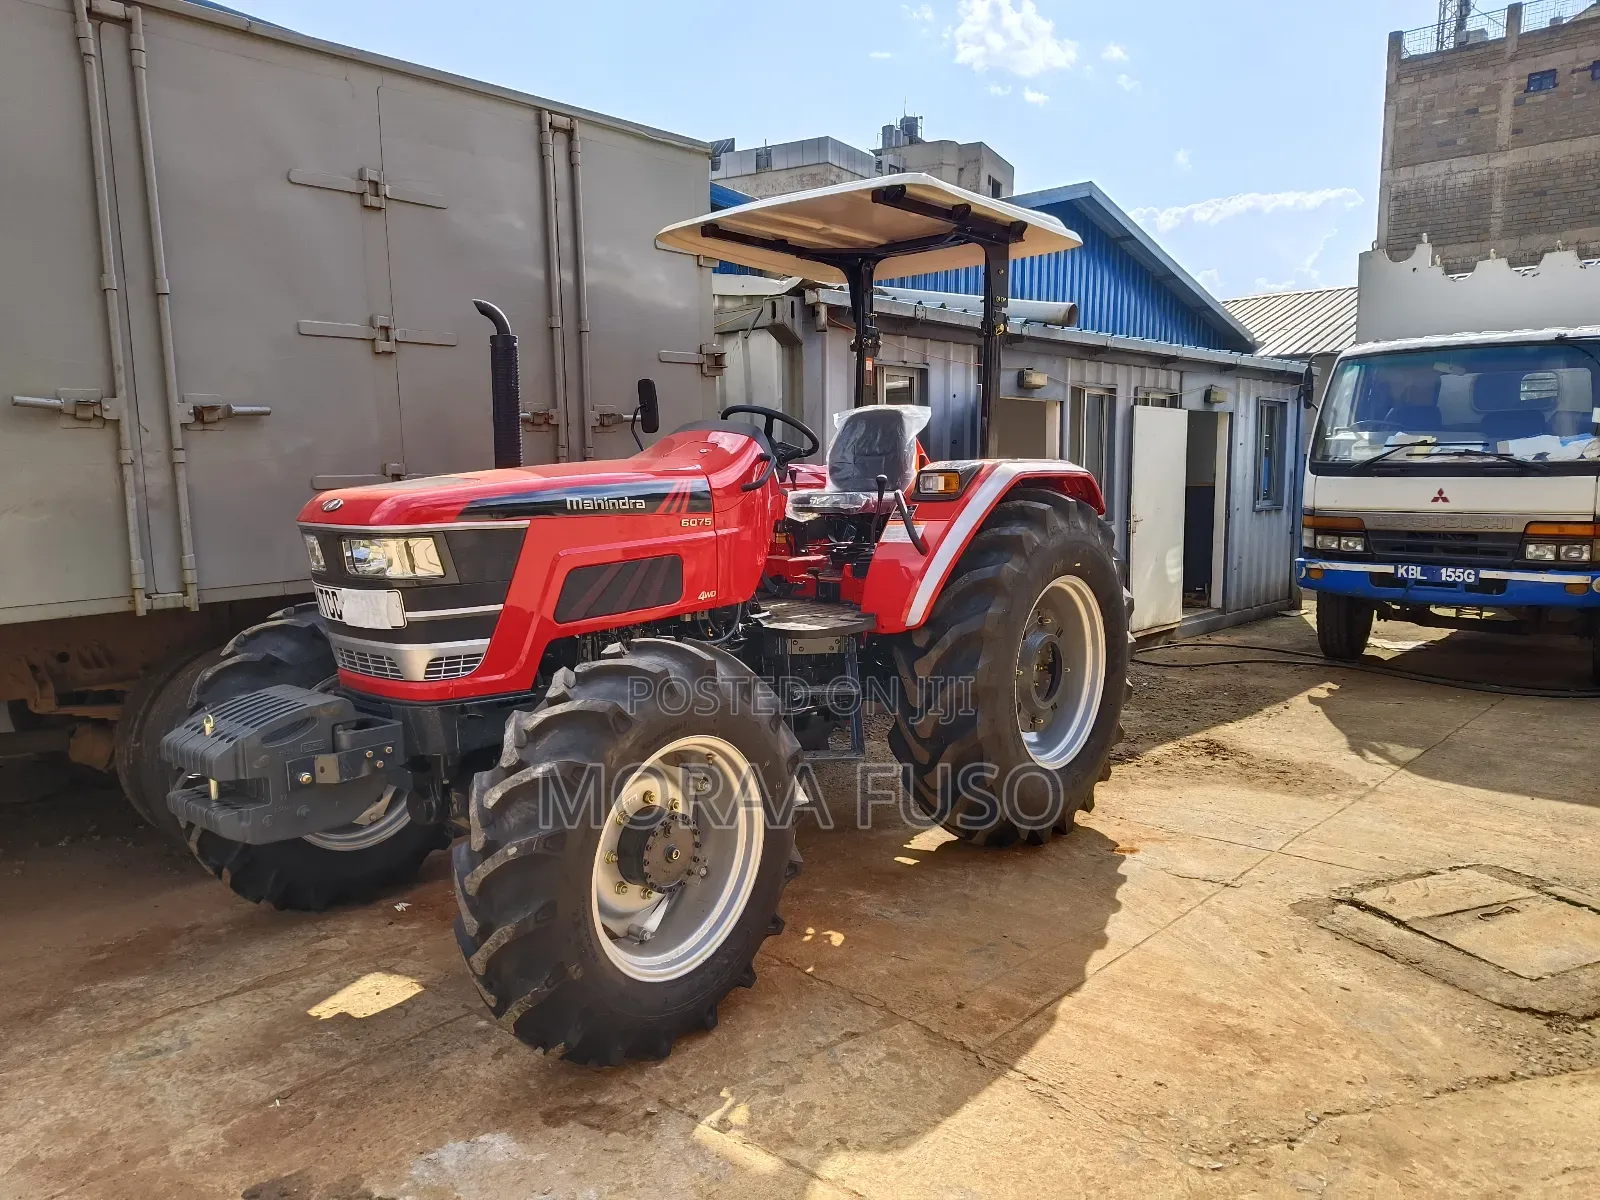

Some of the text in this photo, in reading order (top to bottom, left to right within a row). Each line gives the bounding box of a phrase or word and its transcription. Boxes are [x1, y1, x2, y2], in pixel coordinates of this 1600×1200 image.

[566, 496, 646, 510] Mahindra
[681, 518, 712, 527] 6075
[1397, 564, 1475, 582] KBL 155G
[698, 590, 717, 601] 4WD
